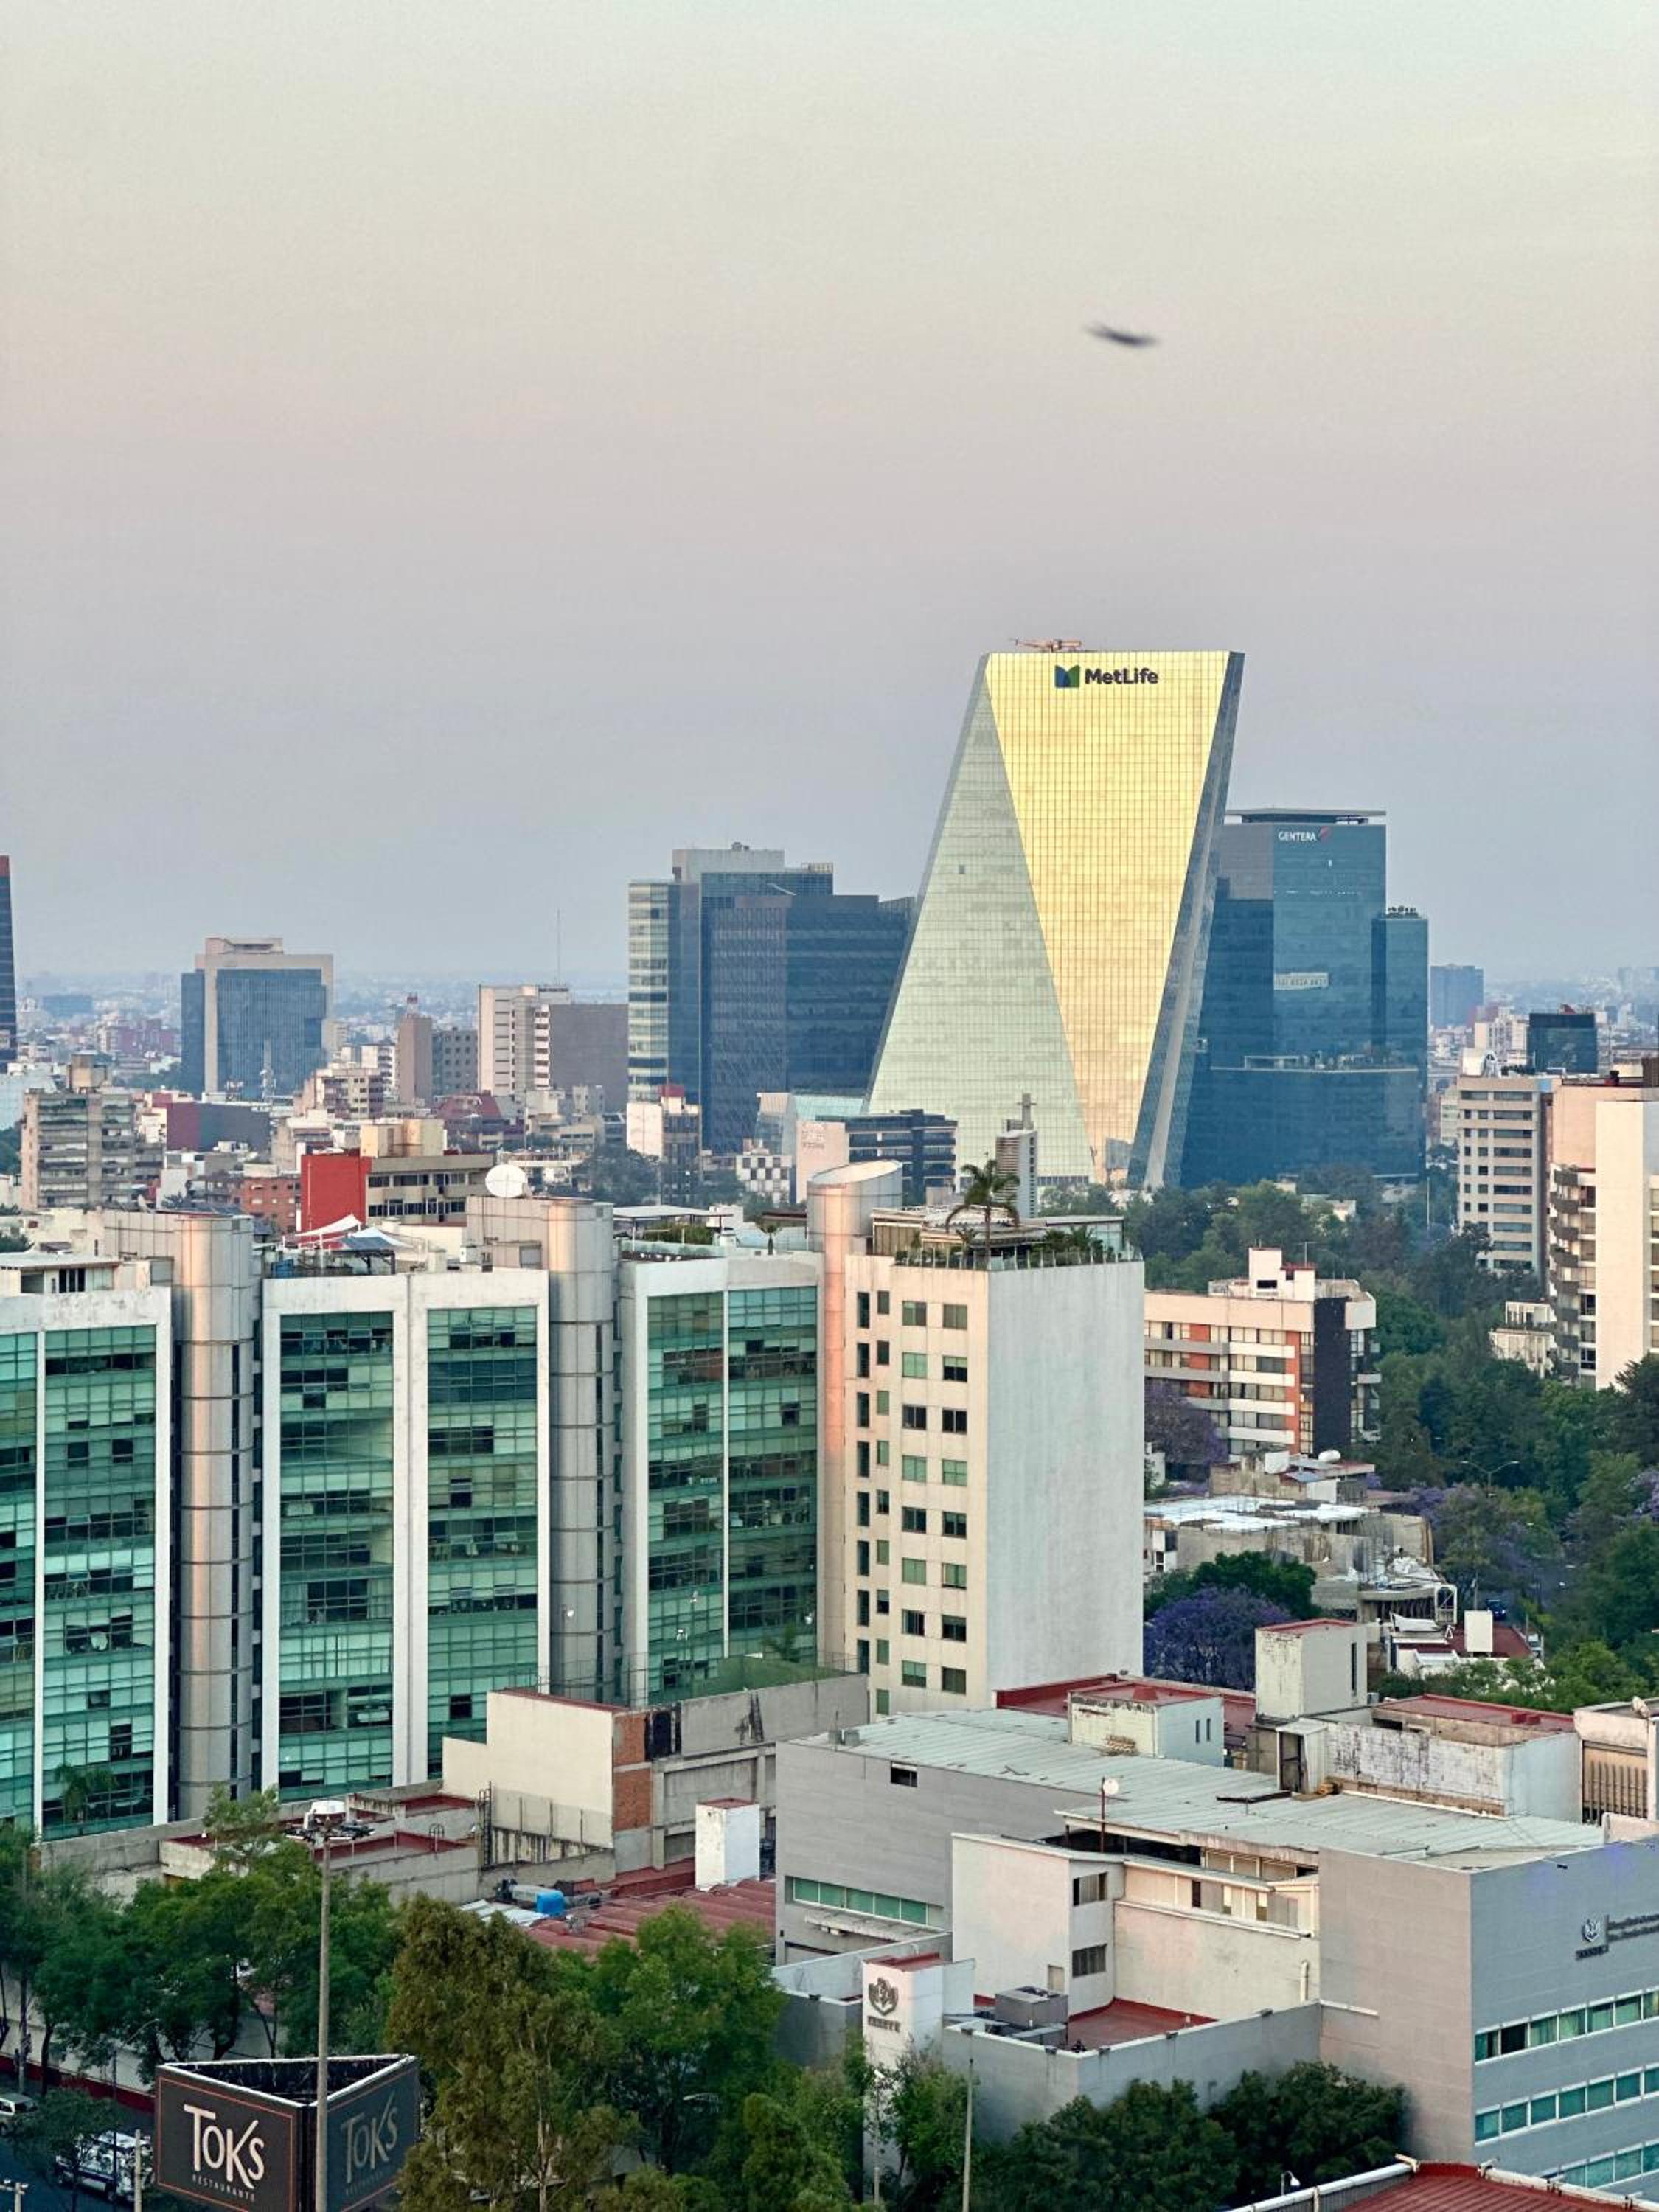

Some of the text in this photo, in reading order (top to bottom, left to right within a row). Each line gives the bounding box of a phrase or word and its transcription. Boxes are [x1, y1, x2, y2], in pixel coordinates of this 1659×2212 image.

[1085, 667, 1158, 684] MetLife
[1278, 831, 1317, 841] GENTERA
[184, 2104, 265, 2189] TOKS
[341, 2090, 398, 2183] TOKS
